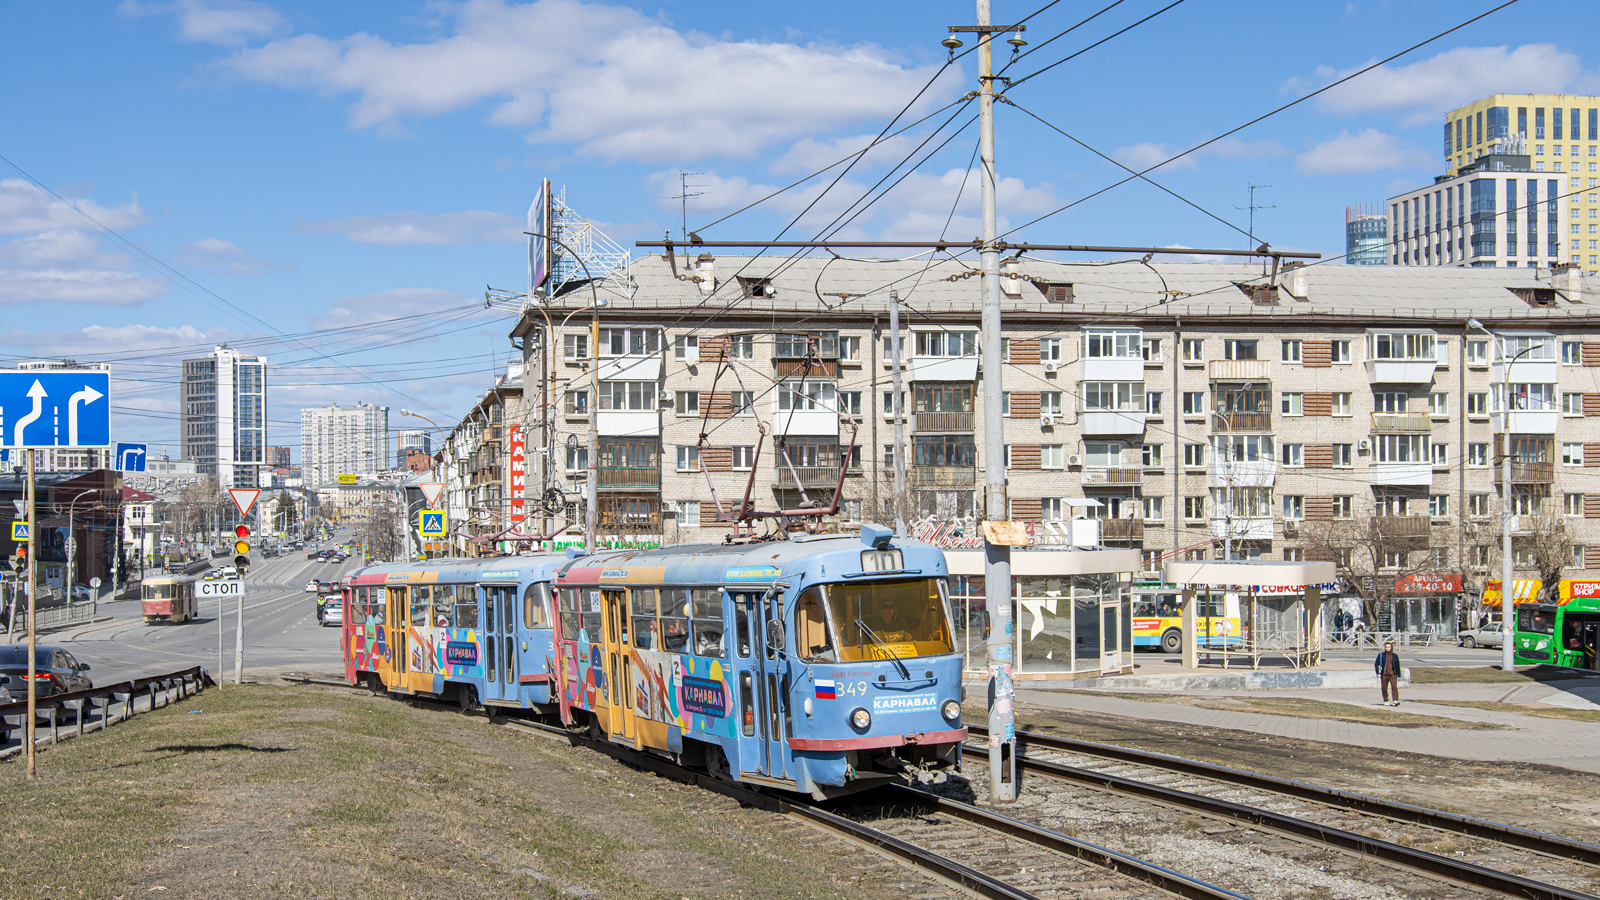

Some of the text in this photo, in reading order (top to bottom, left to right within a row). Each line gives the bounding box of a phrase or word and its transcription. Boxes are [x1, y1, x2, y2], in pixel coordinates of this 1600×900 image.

[512, 431, 525, 515] КАМИНЫ
[910, 520, 984, 548] Цвет
[202, 583, 238, 594] СТОП
[1261, 582, 1336, 593] СОВКОМНК
[1573, 588, 1594, 596] SHOP
[673, 661, 681, 676] 2
[684, 685, 724, 707] КАРНАВАЛ
[836, 681, 867, 697] 349
[873, 697, 937, 709] КАРНАВАЛ
